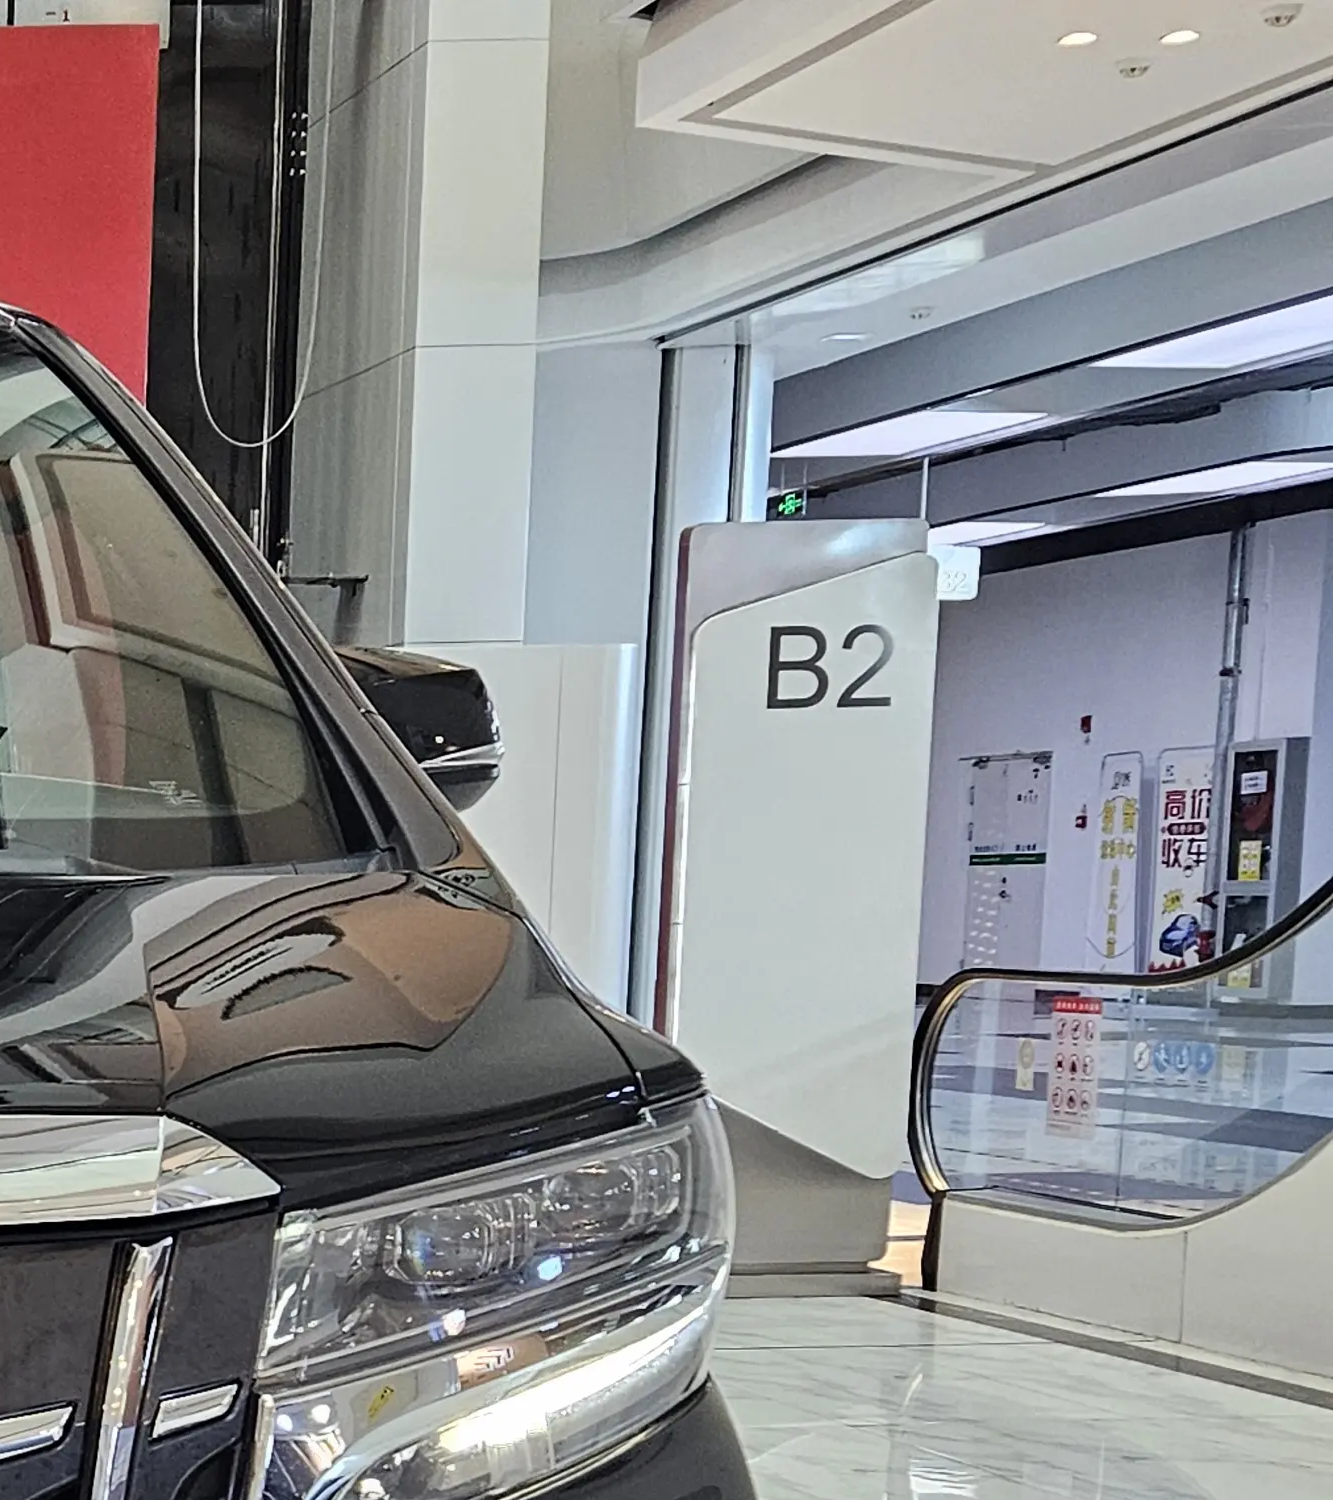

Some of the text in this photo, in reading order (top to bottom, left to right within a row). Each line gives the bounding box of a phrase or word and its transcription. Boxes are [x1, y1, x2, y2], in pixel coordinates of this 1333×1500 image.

[766, 624, 894, 708] B2
[1164, 789, 1213, 819] 高价
[1162, 838, 1208, 868] 收车
